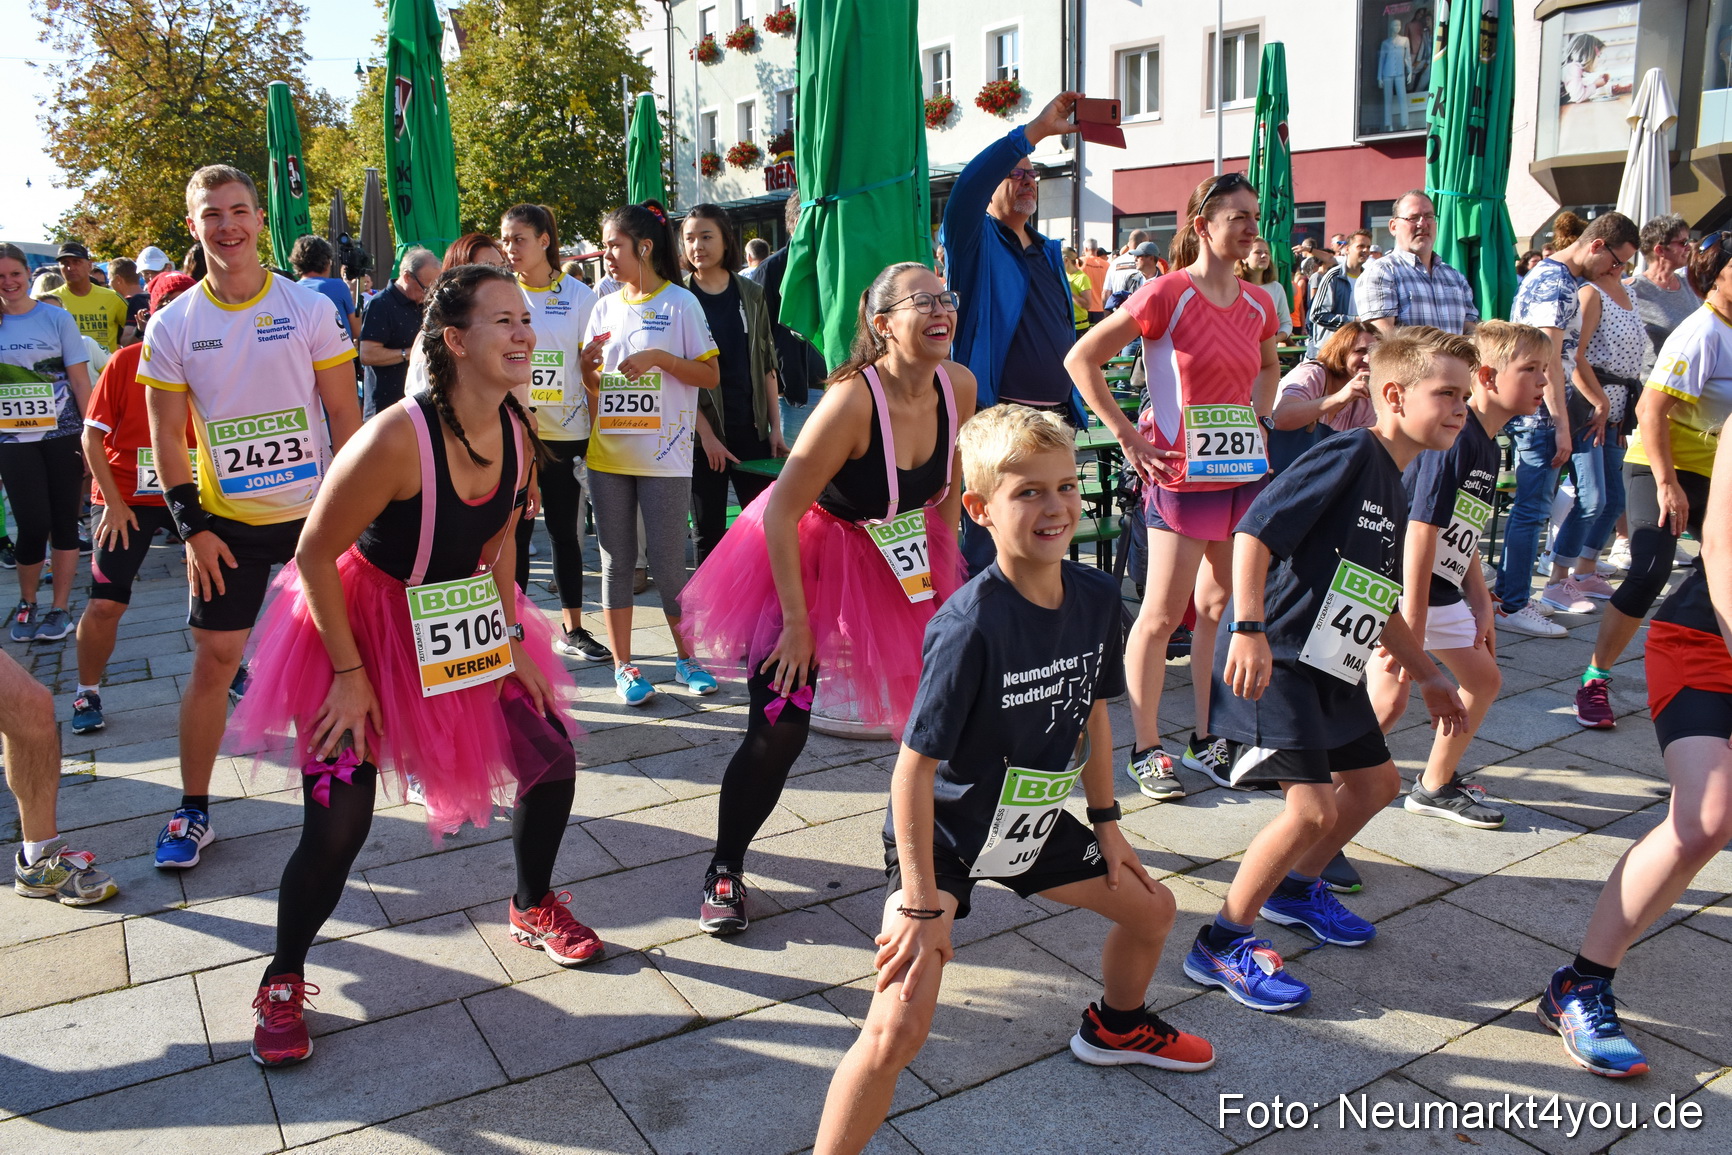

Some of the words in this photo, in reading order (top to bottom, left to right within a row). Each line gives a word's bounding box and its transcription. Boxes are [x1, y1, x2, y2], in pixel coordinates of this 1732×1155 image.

[256, 316, 273, 327] 20
[257, 325, 295, 334] Neumarkter
[258, 333, 290, 342] Stadtlauf
[2, 400, 48, 416] 5133
[604, 393, 654, 413] 5250
[217, 412, 298, 440] BOCK
[610, 418, 649, 428] Nathalie
[1192, 411, 1253, 425] BOCK
[1196, 432, 1255, 456] 2287
[224, 437, 303, 473] 2423
[1206, 463, 1254, 474] SIMONE
[245, 471, 295, 489] JONAS
[876, 515, 926, 540] BOC
[421, 578, 497, 612] BOCK
[429, 610, 503, 656] 5106
[444, 652, 502, 678] VERENA
[1002, 654, 1079, 688] Neumarkter
[1343, 653, 1366, 673] MAX
[1001, 677, 1065, 709] Stadtlauf
